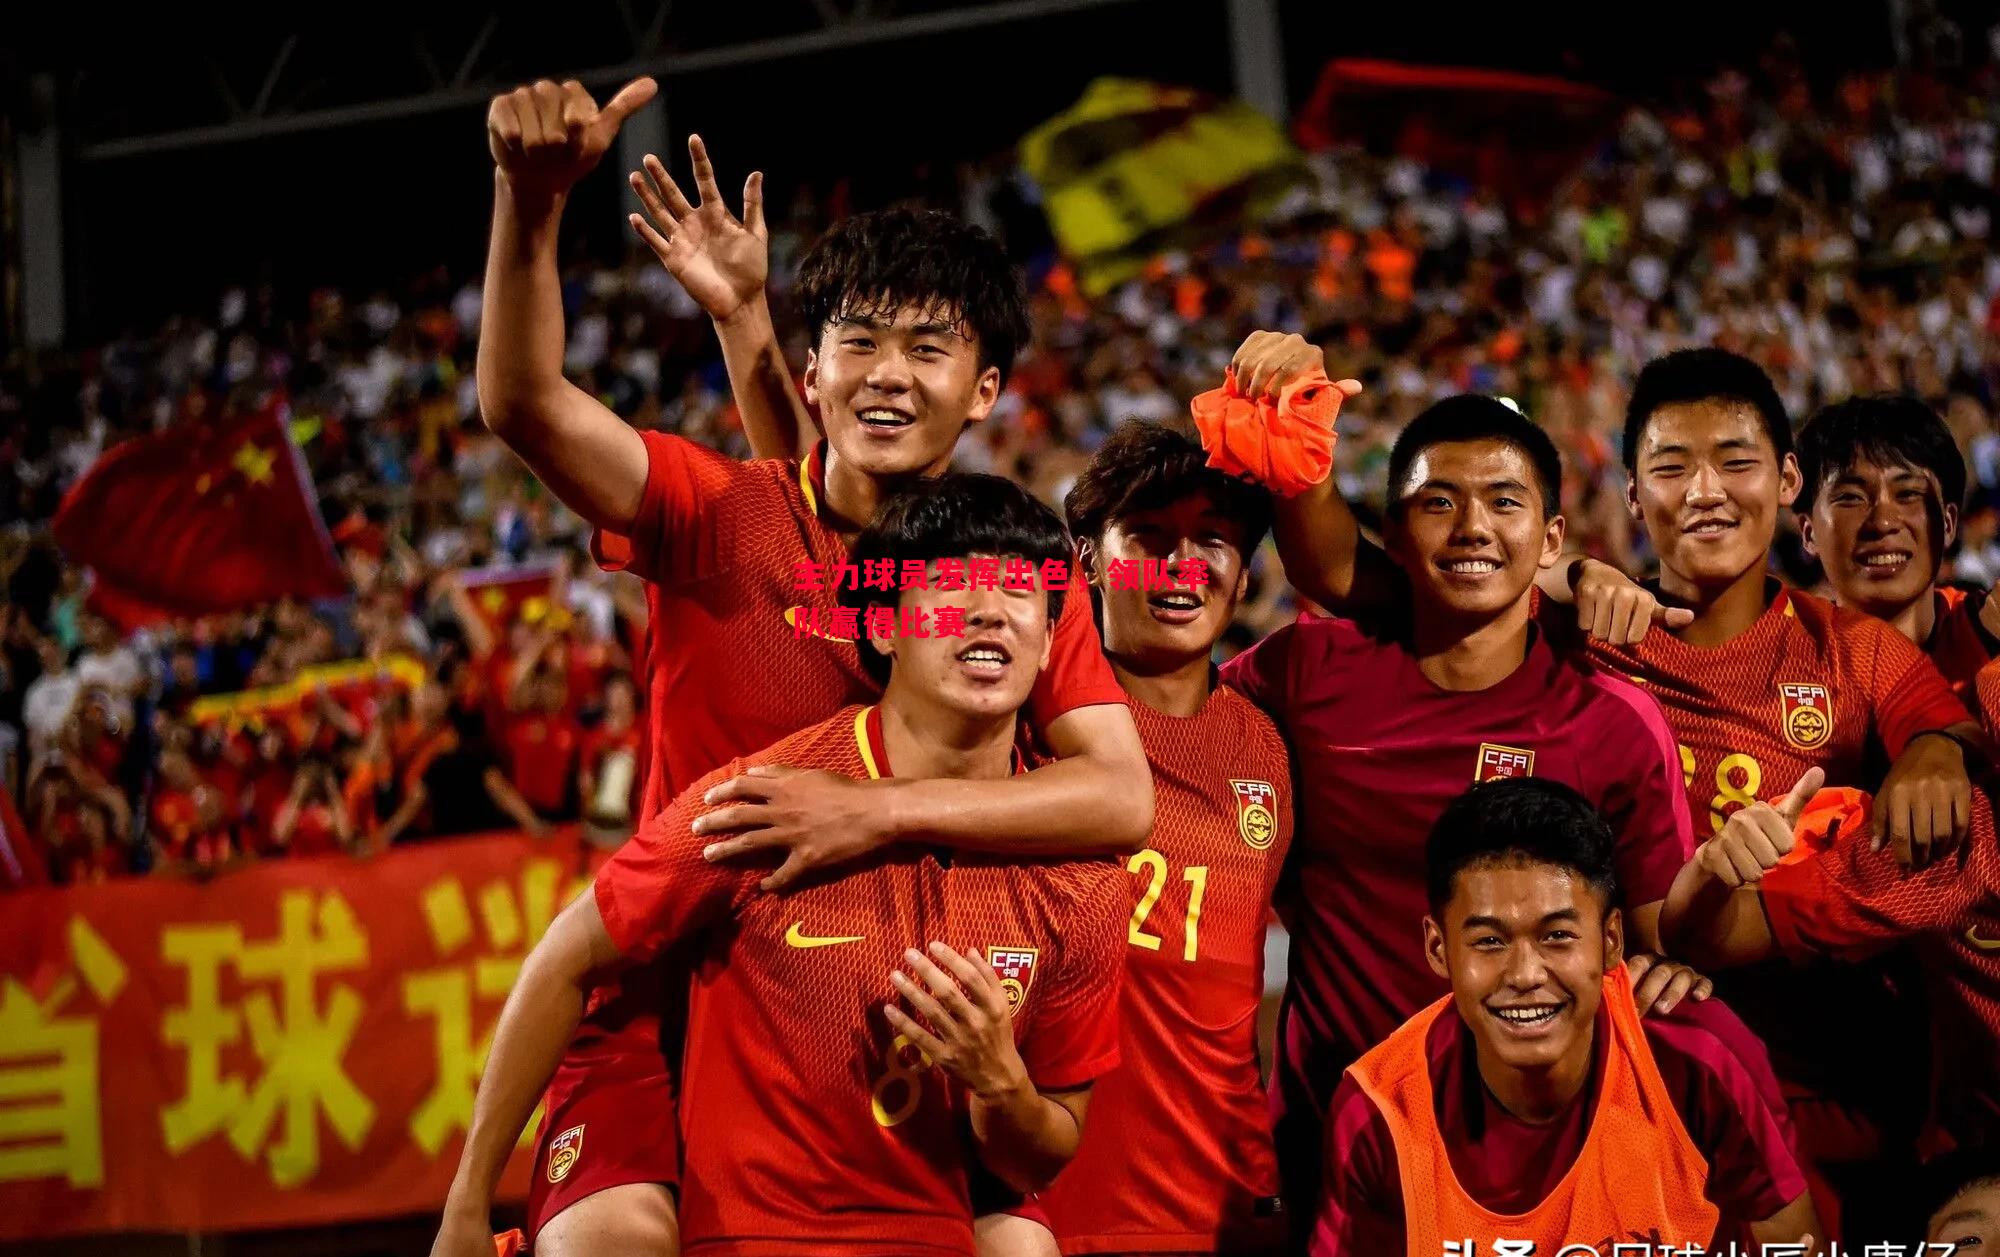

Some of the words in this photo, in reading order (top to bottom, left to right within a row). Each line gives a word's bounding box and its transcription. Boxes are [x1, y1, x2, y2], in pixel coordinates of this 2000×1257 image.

[1783, 686, 1825, 698] CFA
[1797, 697, 1814, 706] 中国
[1484, 749, 1527, 768] CFA
[1495, 765, 1513, 776] 中国
[1234, 782, 1272, 797] CFA
[1126, 848, 1208, 962] 21
[991, 952, 1033, 968] CFA
[1002, 967, 1019, 978] 中国
[871, 1033, 933, 1127] 8
[551, 1127, 581, 1150] CFA
